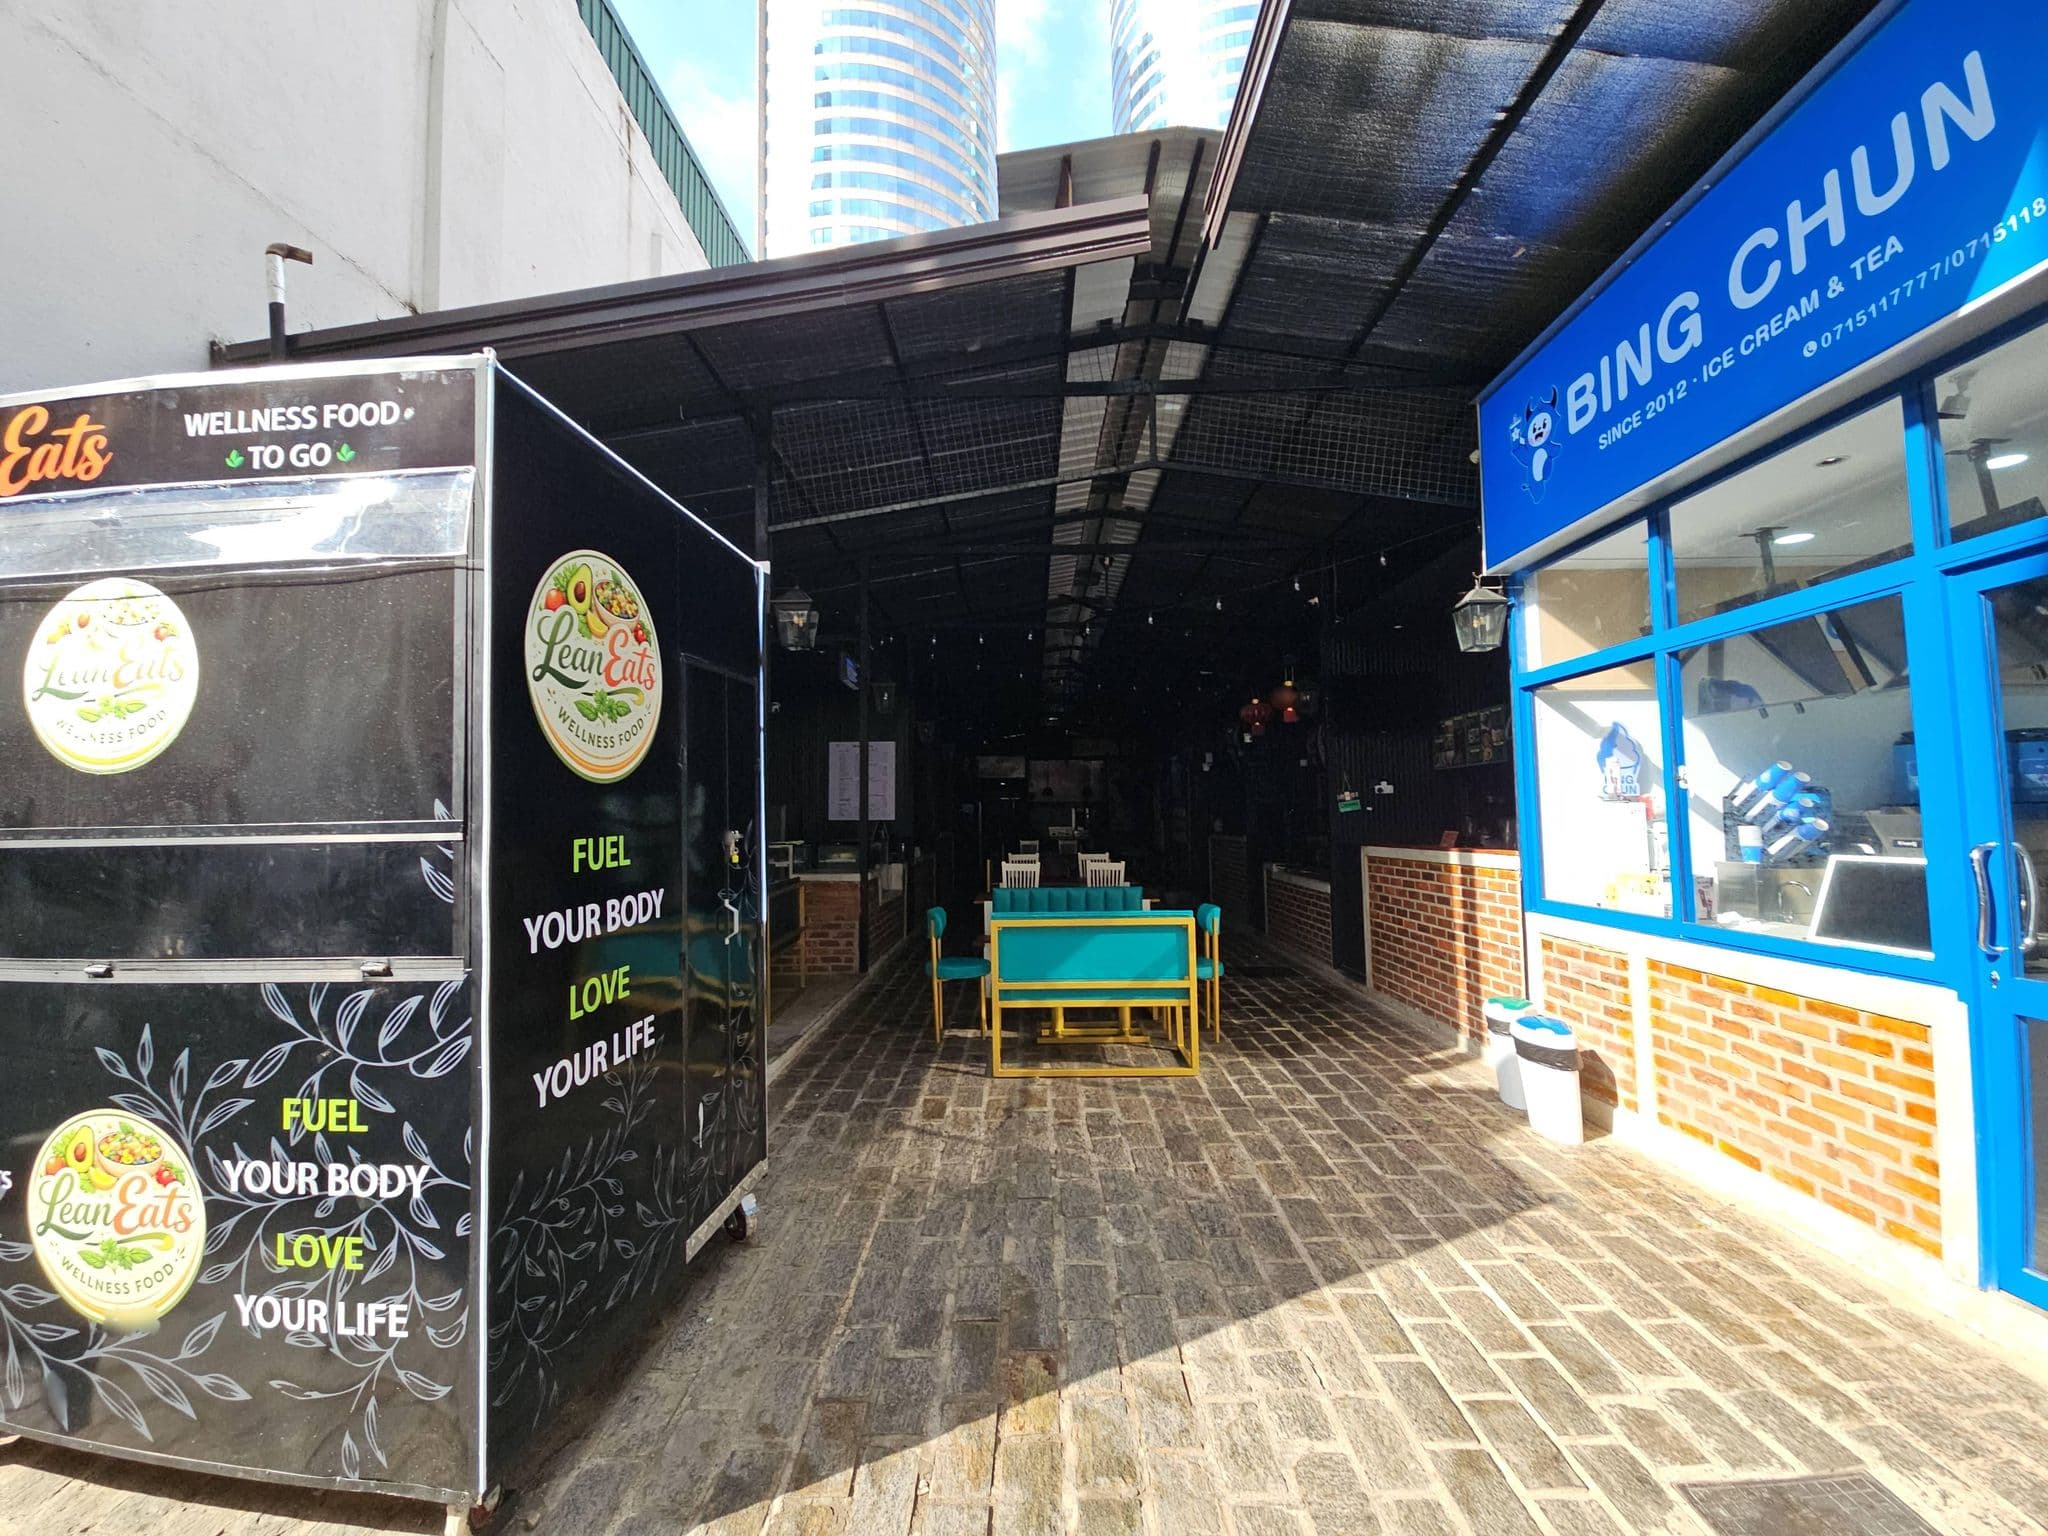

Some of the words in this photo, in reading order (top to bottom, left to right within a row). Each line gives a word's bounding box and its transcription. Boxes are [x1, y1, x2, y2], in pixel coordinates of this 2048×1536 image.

[1567, 291, 1702, 434] BING
[1728, 50, 1996, 309] CHUN
[1599, 410, 1642, 449] SINCE
[1646, 380, 1687, 419] 2012
[1703, 348, 1735, 382] ICE
[1740, 289, 1819, 356] CREAM
[1827, 276, 1845, 298] &
[1850, 235, 1904, 280] TEA
[184, 404, 317, 437] WELLNESS
[323, 401, 399, 428] FOOD
[0, 405, 113, 496] Eats
[248, 445, 284, 470] TO
[290, 442, 331, 468] GO
[558, 706, 615, 748] WELLNESS
[619, 718, 644, 745] FOOD
[573, 835, 631, 873] FUEL
[523, 903, 601, 954] YOUR
[606, 888, 664, 933] BODY
[570, 965, 630, 1020] LOVE
[533, 1040, 607, 1108] YOUR
[613, 1015, 655, 1066] LIFE
[283, 1098, 368, 1132] FUEL
[223, 1160, 320, 1196] YOUR
[327, 1164, 430, 1199] BODY
[275, 1233, 363, 1270] LOVE
[62, 1256, 130, 1294] WELLNESS
[135, 1263, 174, 1294] FOOD
[233, 1294, 327, 1333] YOUR
[337, 1303, 408, 1337] LIFE
